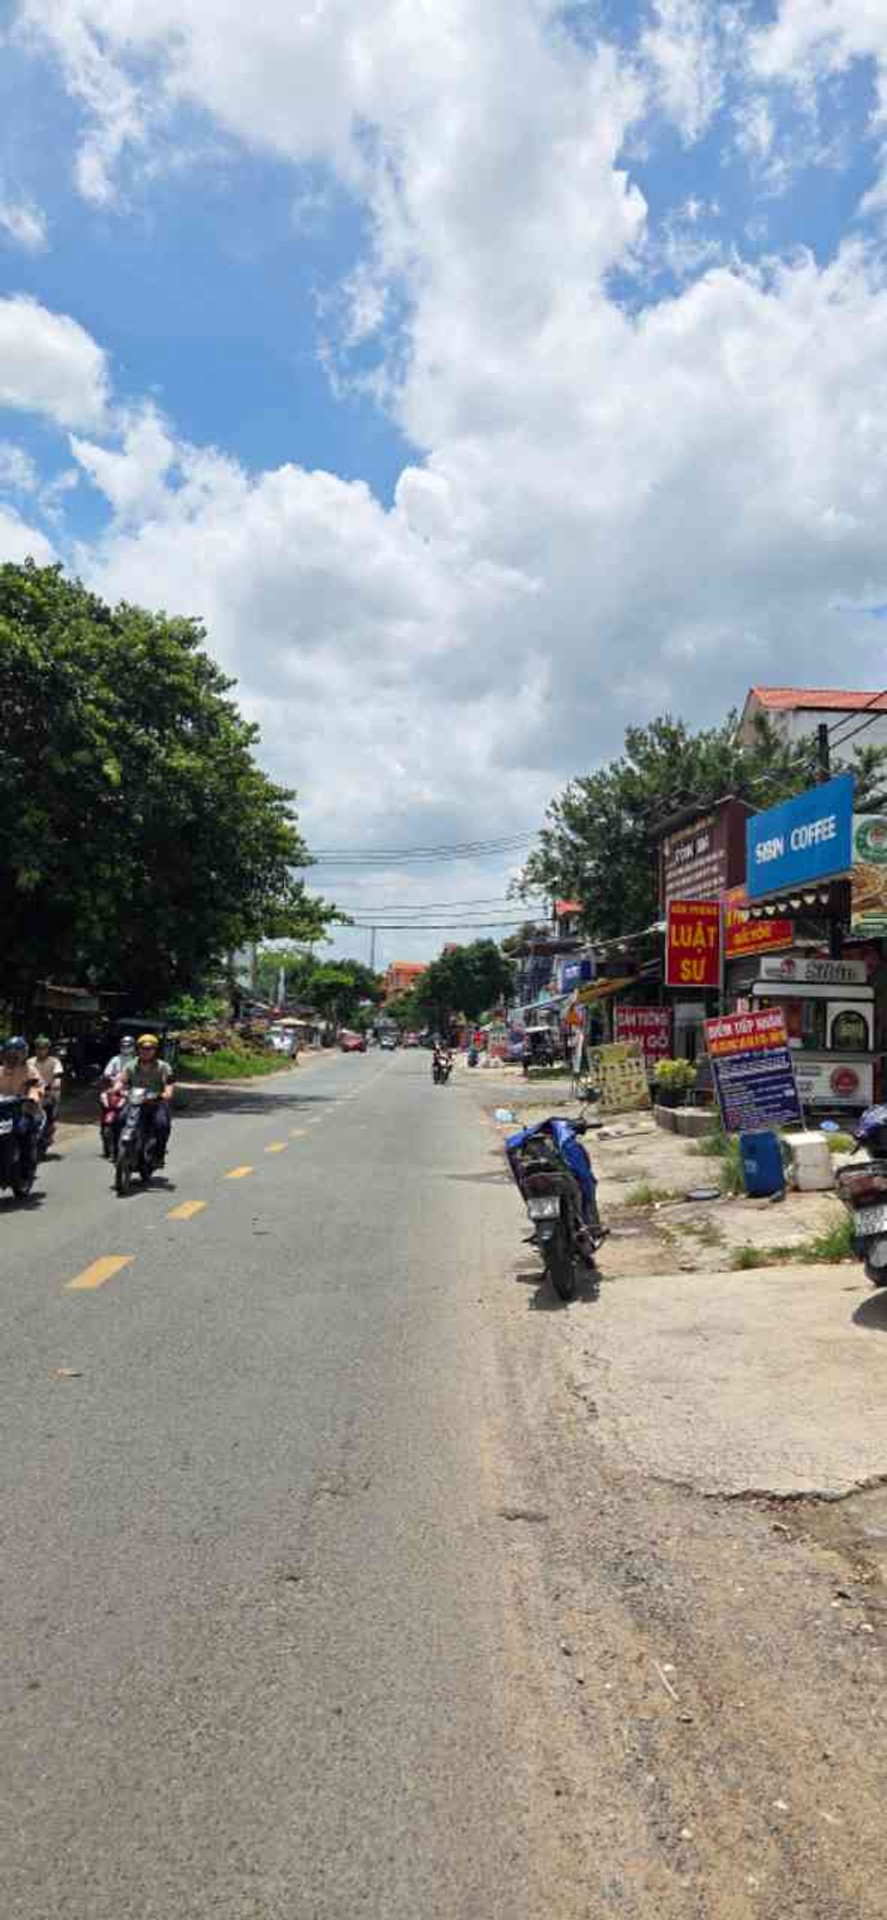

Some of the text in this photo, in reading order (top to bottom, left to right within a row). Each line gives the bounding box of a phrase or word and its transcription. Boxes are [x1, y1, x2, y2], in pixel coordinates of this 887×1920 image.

[791, 815, 837, 850] COFFEE
[671, 921, 718, 954] LUẬT
[681, 956, 707, 981] SƯ
